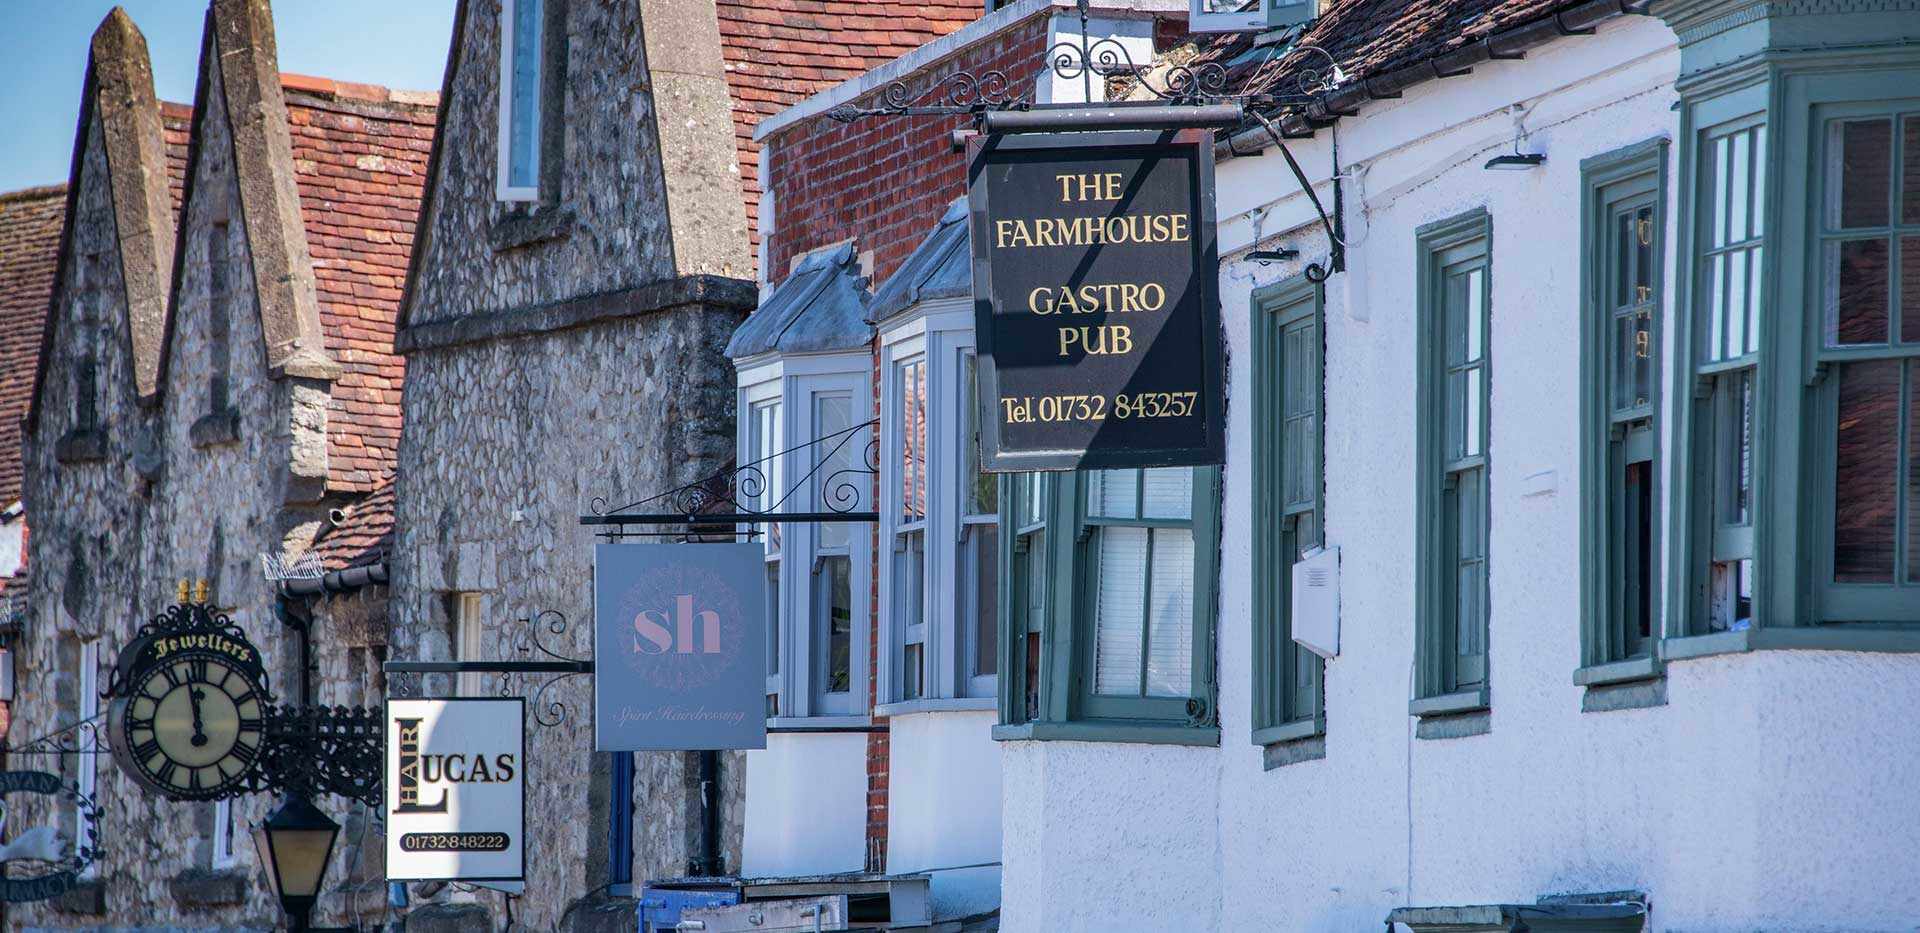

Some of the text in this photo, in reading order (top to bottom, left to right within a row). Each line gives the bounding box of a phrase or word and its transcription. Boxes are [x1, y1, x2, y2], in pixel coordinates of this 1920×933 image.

[1056, 172, 1126, 202] THE
[995, 213, 1191, 249] FARMHOUSE
[1028, 282, 1166, 316] GASTRO
[1057, 325, 1134, 357] PUB
[1001, 391, 1198, 424] Tel. 01732 843257
[633, 593, 721, 655] sh
[154, 633, 250, 661] Jewellers
[401, 726, 419, 807] HAIR
